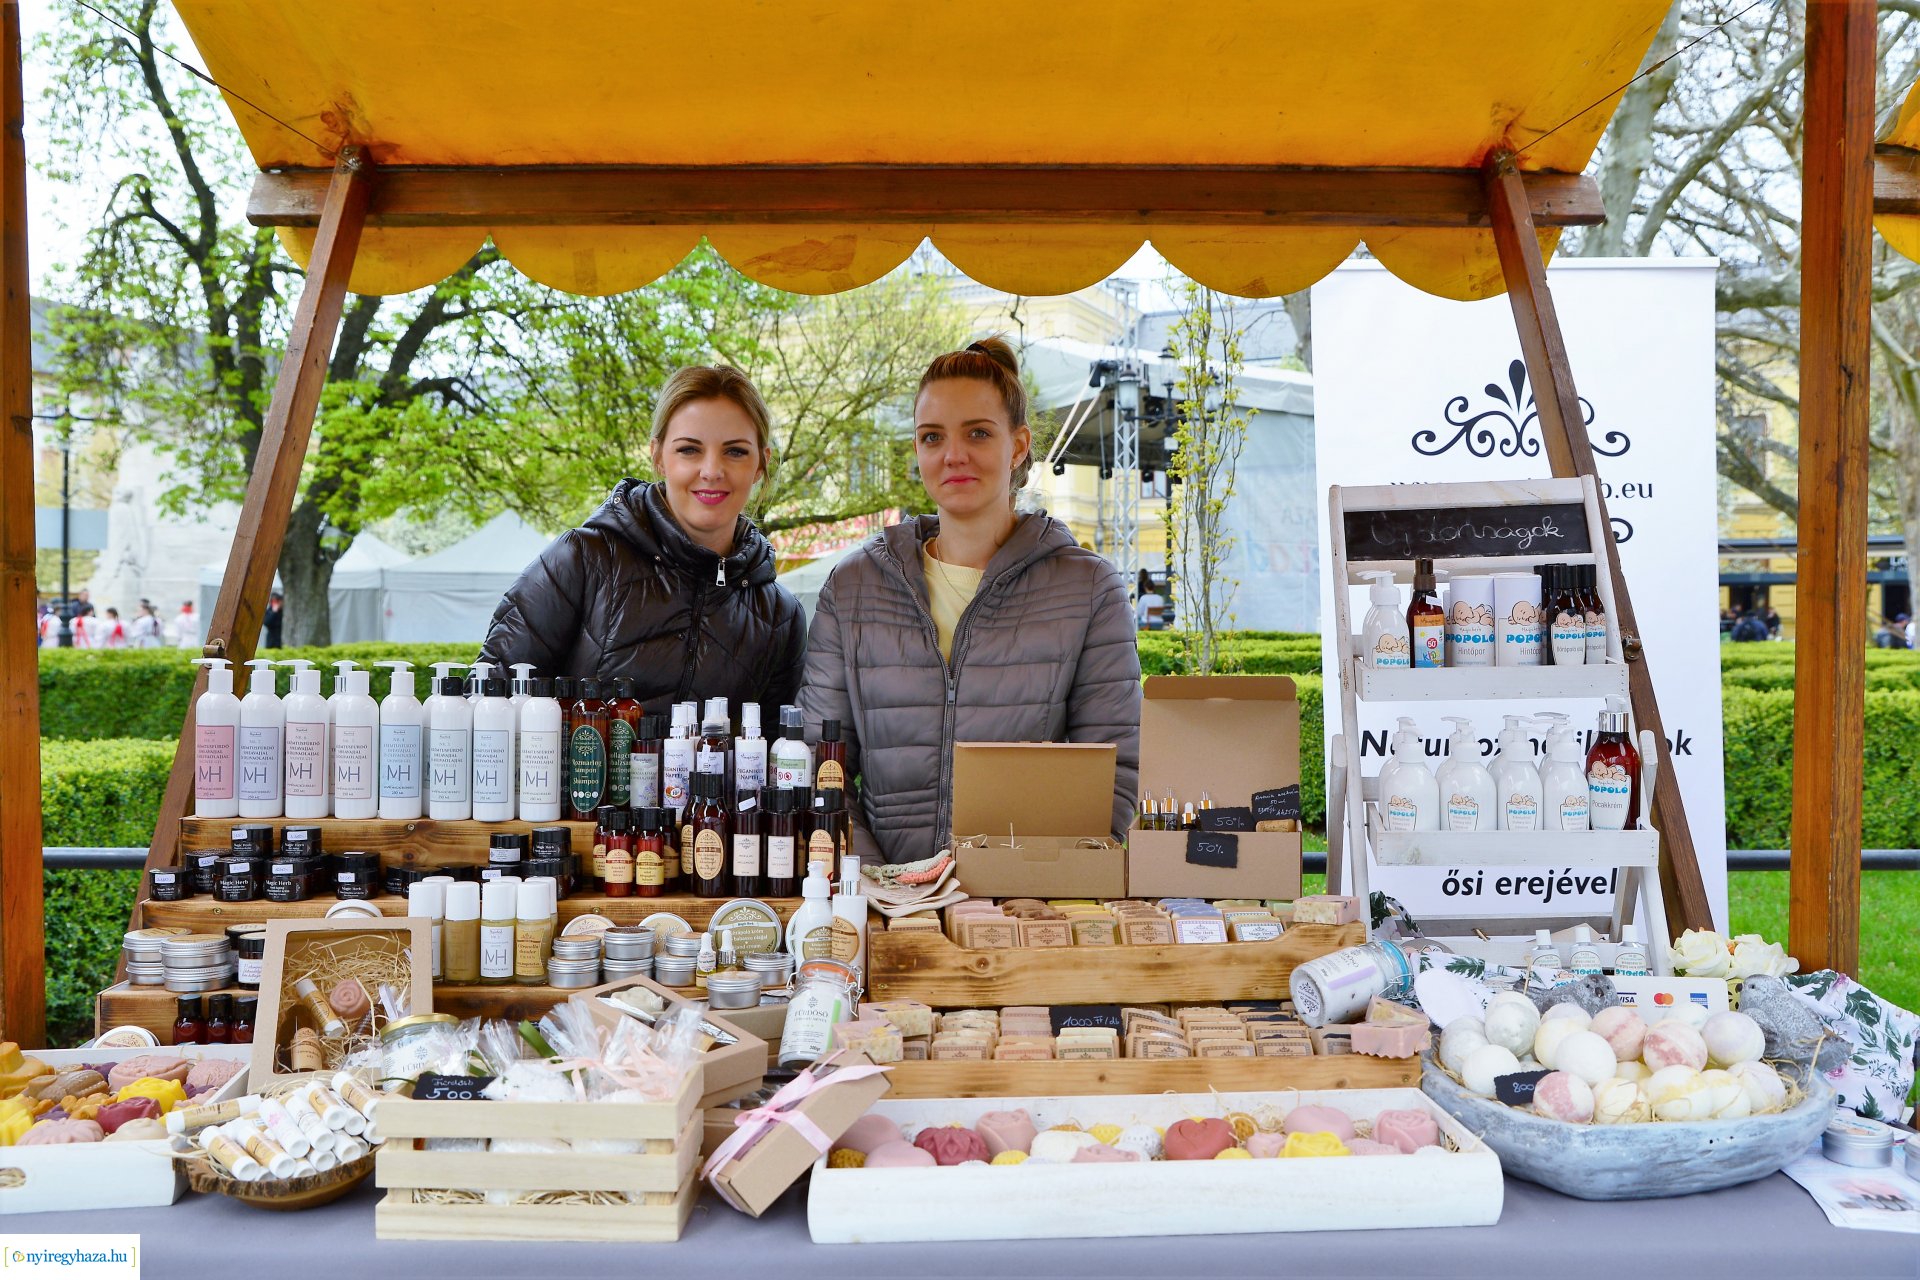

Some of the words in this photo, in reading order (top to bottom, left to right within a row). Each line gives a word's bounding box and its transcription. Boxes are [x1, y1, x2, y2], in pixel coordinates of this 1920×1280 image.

[199, 766, 221, 782] MH
[243, 766, 267, 783] MH
[289, 762, 312, 779] MH
[338, 766, 360, 782] MH
[387, 764, 411, 781] MH
[434, 769, 456, 786] MH
[476, 769, 497, 786] MH
[525, 771, 548, 787] MH
[1589, 784, 1628, 794] POPOLÓ
[1215, 816, 1245, 828] 50%
[1197, 842, 1224, 855] 50%
[1442, 869, 1483, 897] ősi
[1495, 867, 1617, 904] erejével
[486, 948, 507, 965] MH
[425, 1087, 472, 1100] 500
